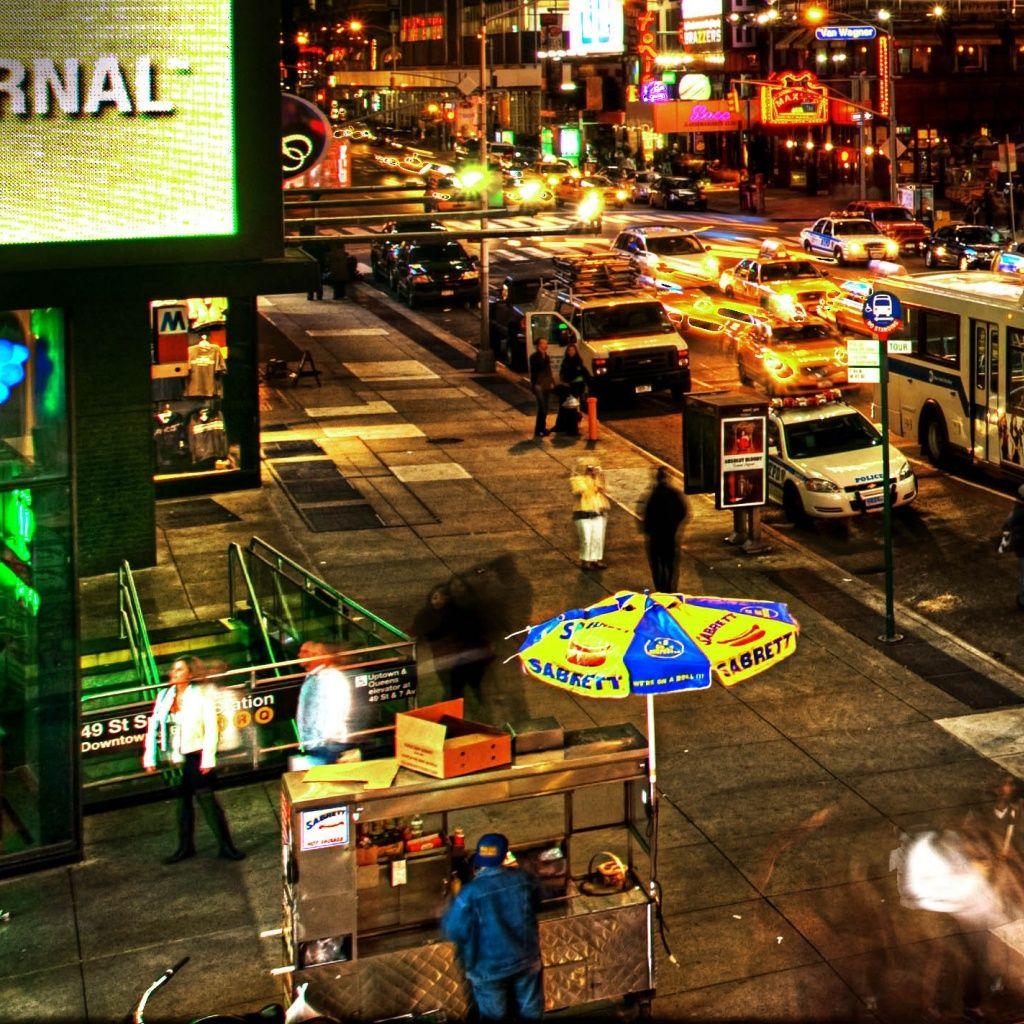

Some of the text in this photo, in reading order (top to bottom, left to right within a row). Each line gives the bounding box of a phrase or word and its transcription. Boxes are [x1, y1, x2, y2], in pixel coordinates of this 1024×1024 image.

[820, 28, 873, 38] Van Wagner
[890, 343, 908, 351] TOUR
[696, 613, 737, 645] SABRETT
[717, 633, 793, 678] SABRETT
[369, 670, 399, 680] Uptown
[529, 658, 623, 691] SABRETT
[81, 723, 103, 739] 49
[108, 718, 130, 734] St
[81, 733, 146, 752] Downtow
